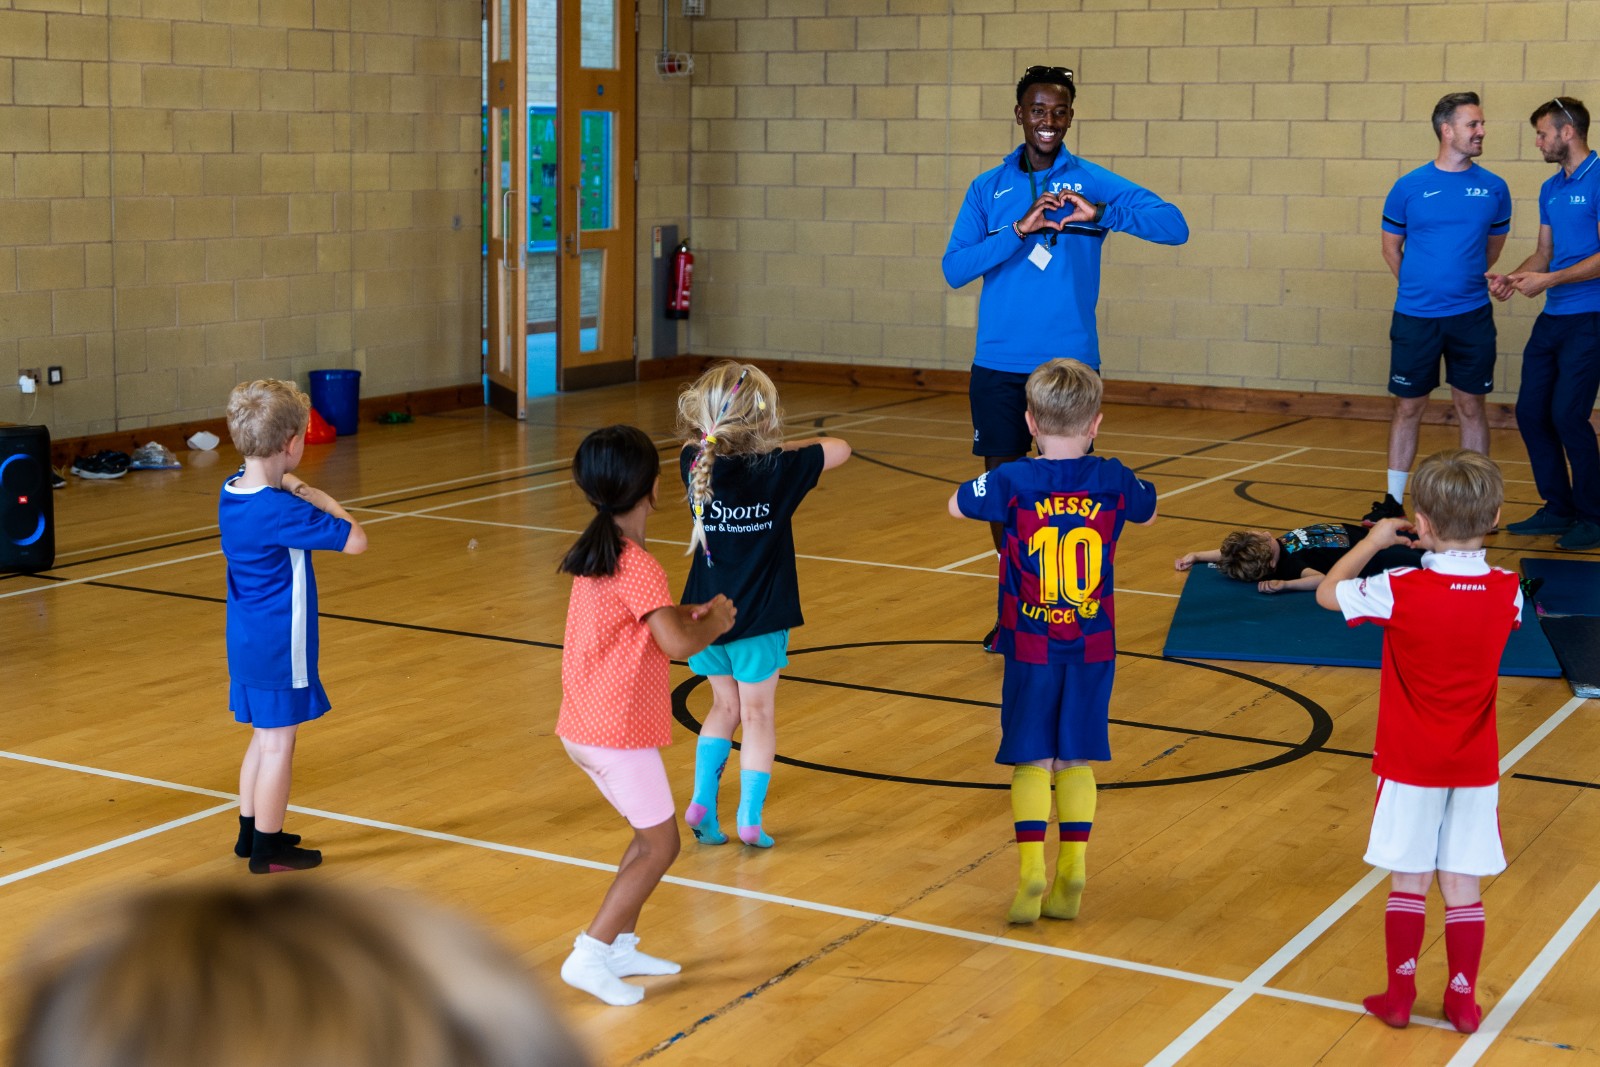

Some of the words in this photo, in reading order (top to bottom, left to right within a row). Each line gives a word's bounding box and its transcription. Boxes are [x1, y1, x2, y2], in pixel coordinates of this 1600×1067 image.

[976, 470, 987, 497] eko
[710, 500, 770, 523] Sports
[1034, 496, 1102, 521] MESSI
[718, 523, 726, 532] &
[726, 520, 773, 533] Embroidery
[1028, 526, 1103, 606] 10
[1450, 583, 1487, 591] ARSENAL
[1450, 982, 1472, 994] adidas
